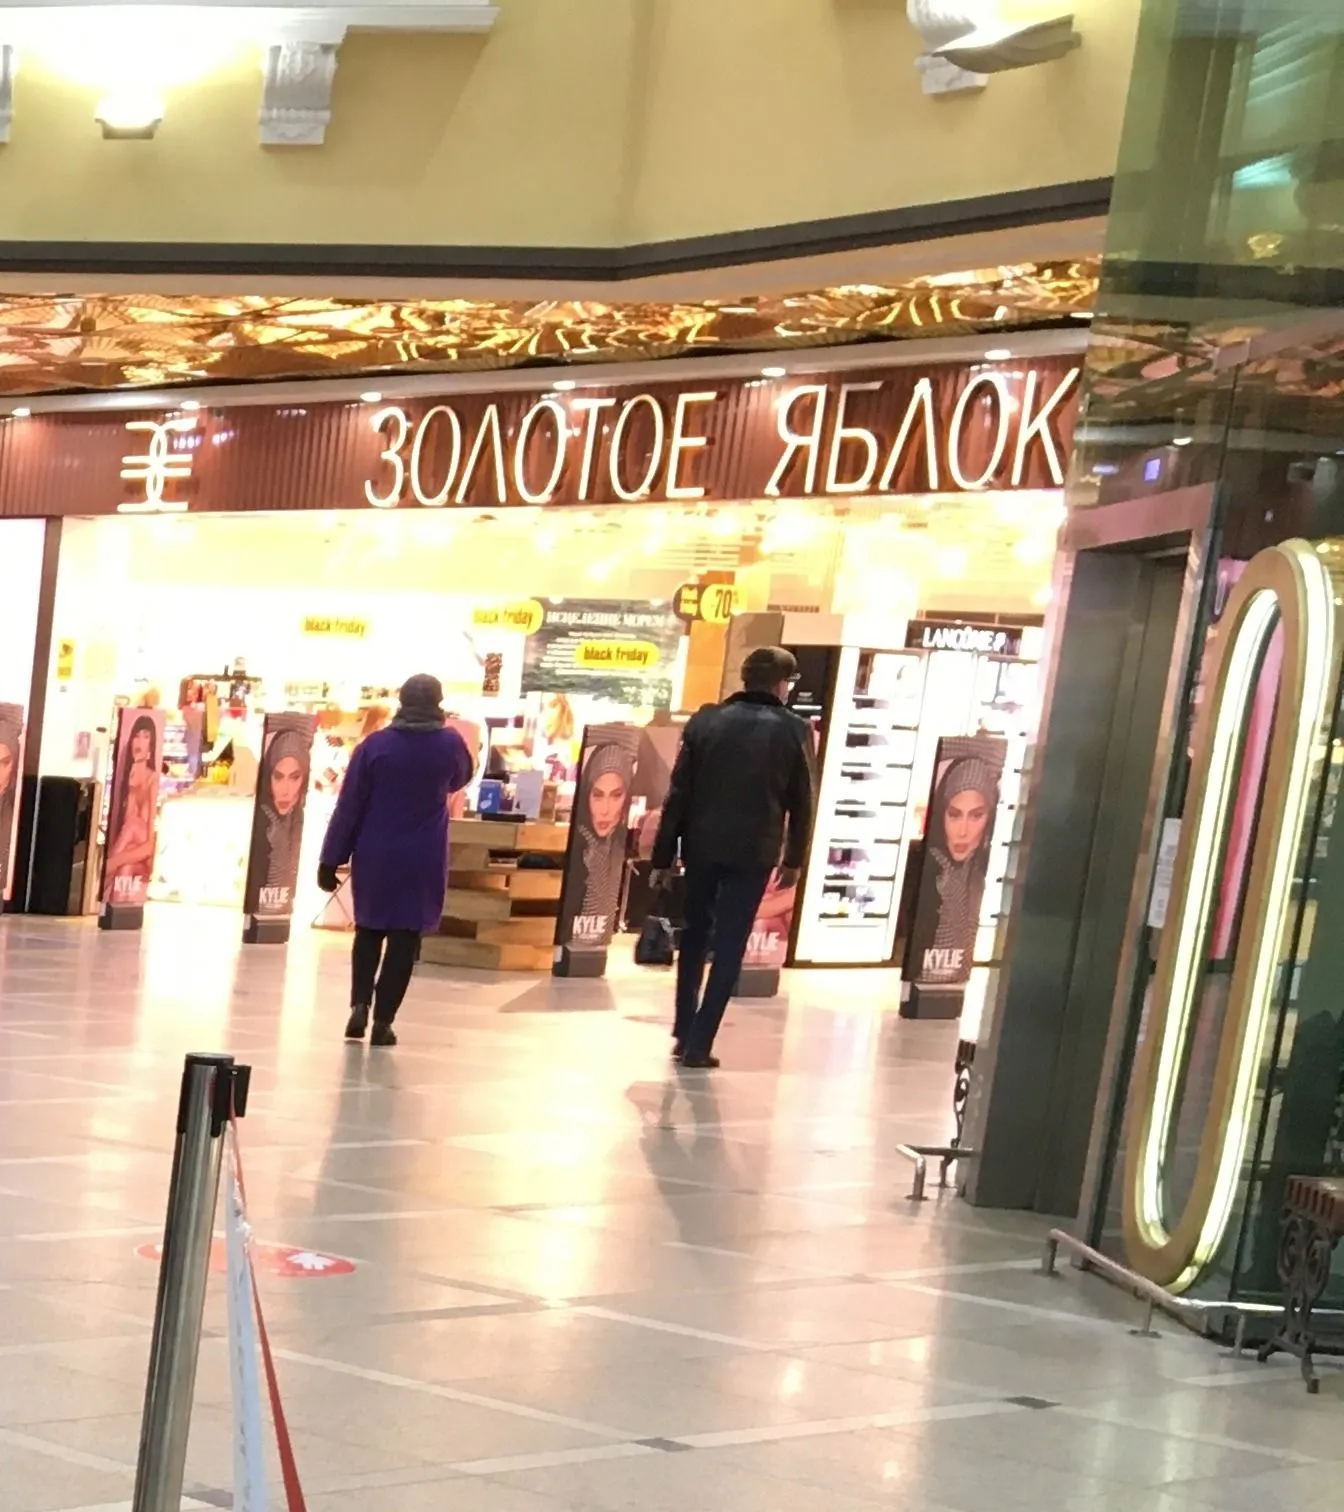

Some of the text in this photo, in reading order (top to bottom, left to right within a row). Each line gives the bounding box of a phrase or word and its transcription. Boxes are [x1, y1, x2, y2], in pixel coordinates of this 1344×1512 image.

[365, 367, 1080, 508] ЗОЛОТОЕ ЯБЛОК
[304, 616, 365, 637] black friday
[503, 608, 534, 629] friday
[583, 646, 649, 665] black friday
[114, 875, 143, 892] KYLIE
[258, 886, 289, 904] KYLIE
[572, 914, 607, 935] KYLIE
[923, 948, 964, 970] KYLIE
